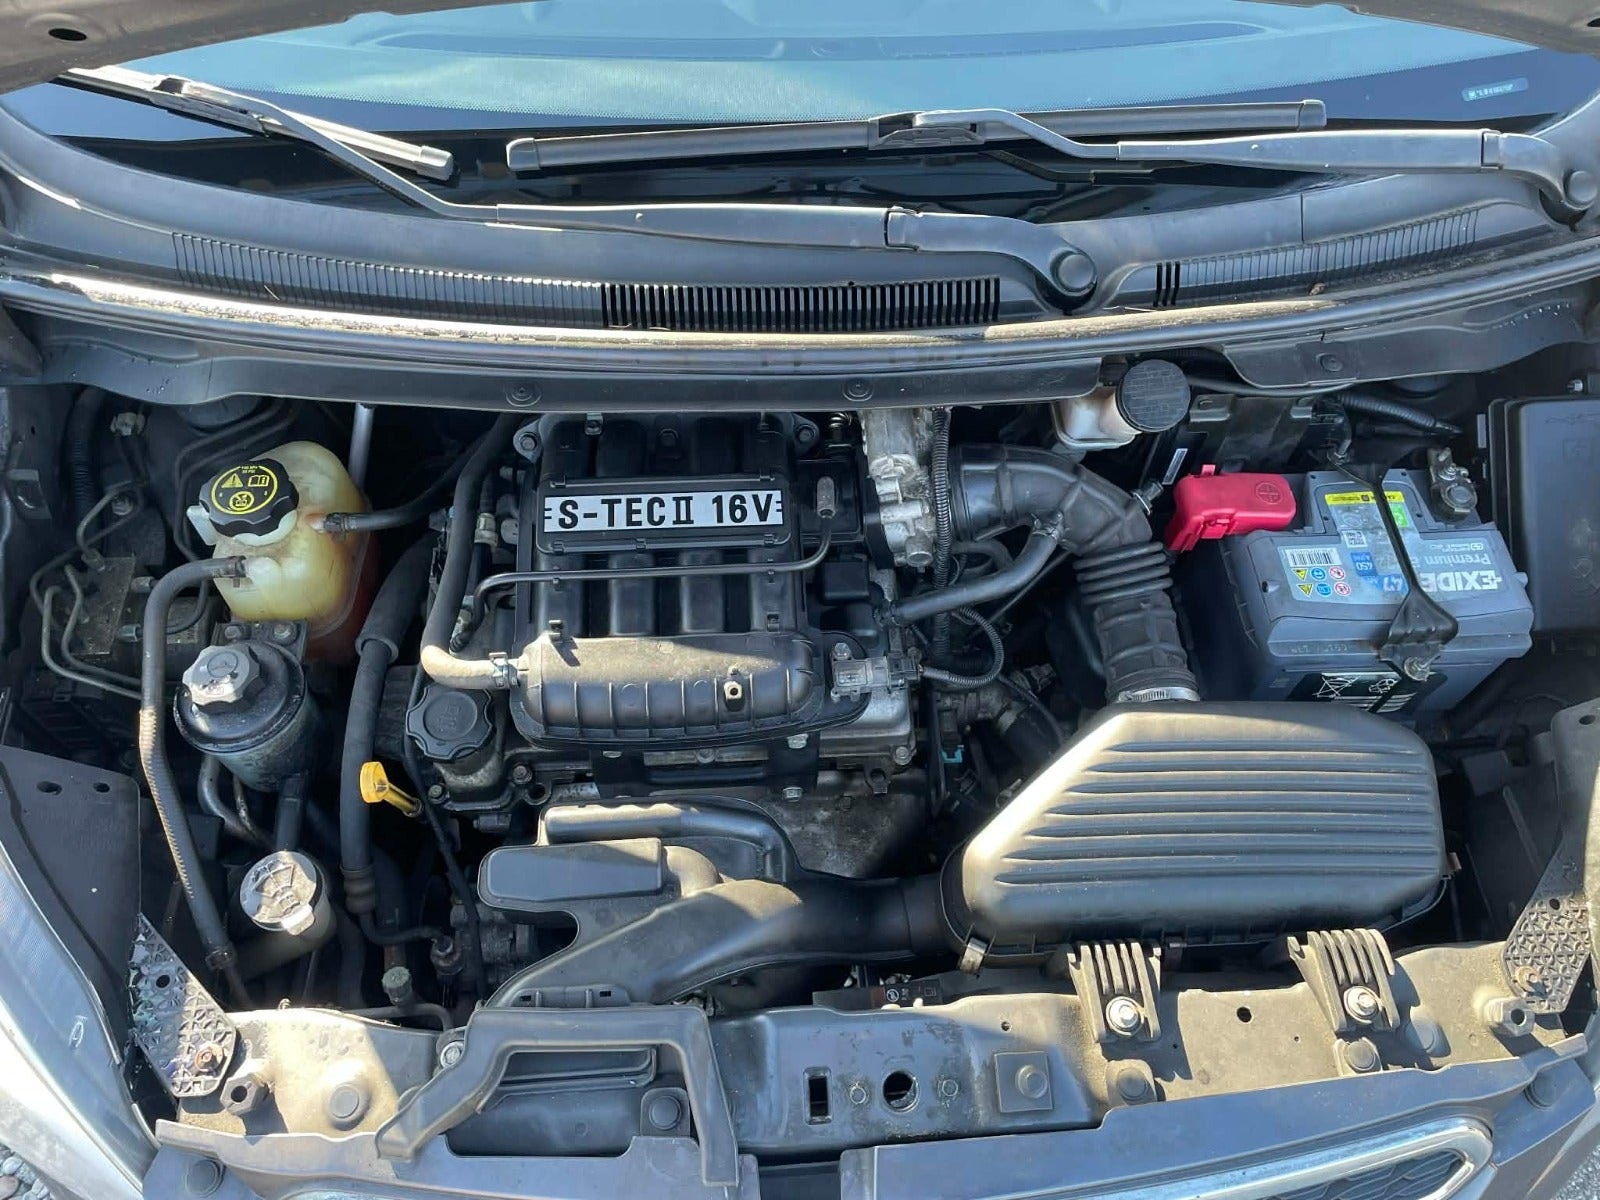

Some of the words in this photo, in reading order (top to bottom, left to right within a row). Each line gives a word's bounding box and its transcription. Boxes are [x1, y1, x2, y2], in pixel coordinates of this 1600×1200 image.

[712, 493, 774, 524] 16V
[1356, 561, 1373, 571] 450
[1424, 553, 1492, 566] Premium
[1419, 570, 1502, 593] EXIDE
